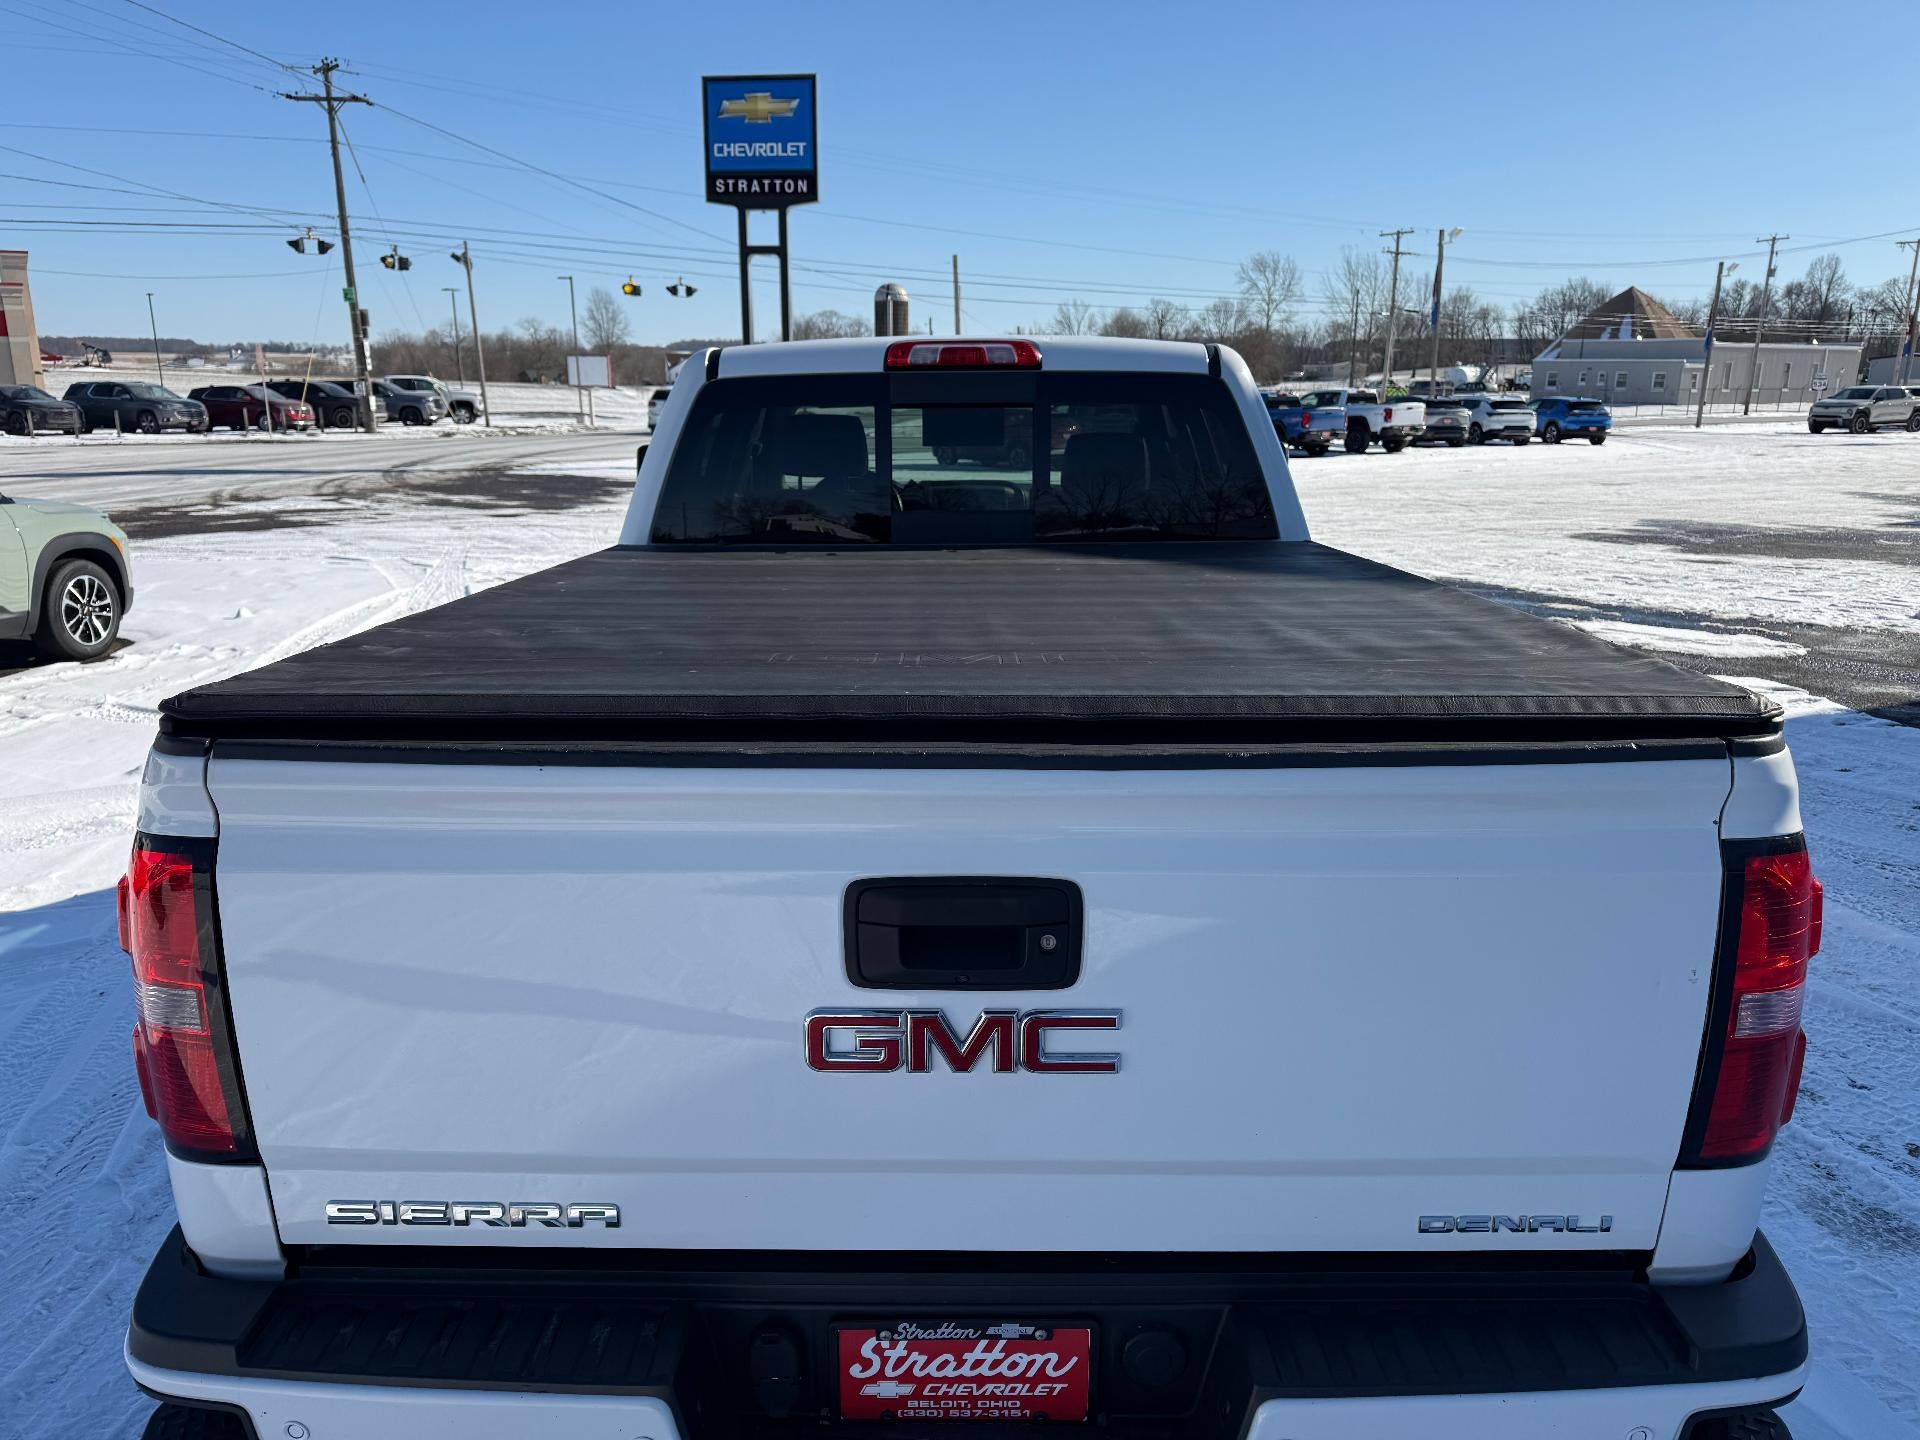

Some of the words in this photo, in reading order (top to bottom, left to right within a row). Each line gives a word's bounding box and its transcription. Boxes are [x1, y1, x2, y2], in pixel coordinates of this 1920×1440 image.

[713, 142, 807, 157] CHEVROLET
[715, 179, 808, 193] STRATTON
[804, 1007, 1123, 1074] GMC
[325, 1200, 622, 1228] SIERRA
[1418, 1215, 1613, 1234] DENALI
[893, 1322, 982, 1340] Stratton
[849, 1337, 1079, 1379] Stratton
[922, 1383, 1069, 1396] CHEVROLET
[907, 1400, 971, 1409] BELOIT,
[977, 1400, 1021, 1408] OHIO
[897, 1409, 944, 1418] (330)
[949, 1409, 1031, 1417] 537-3151
